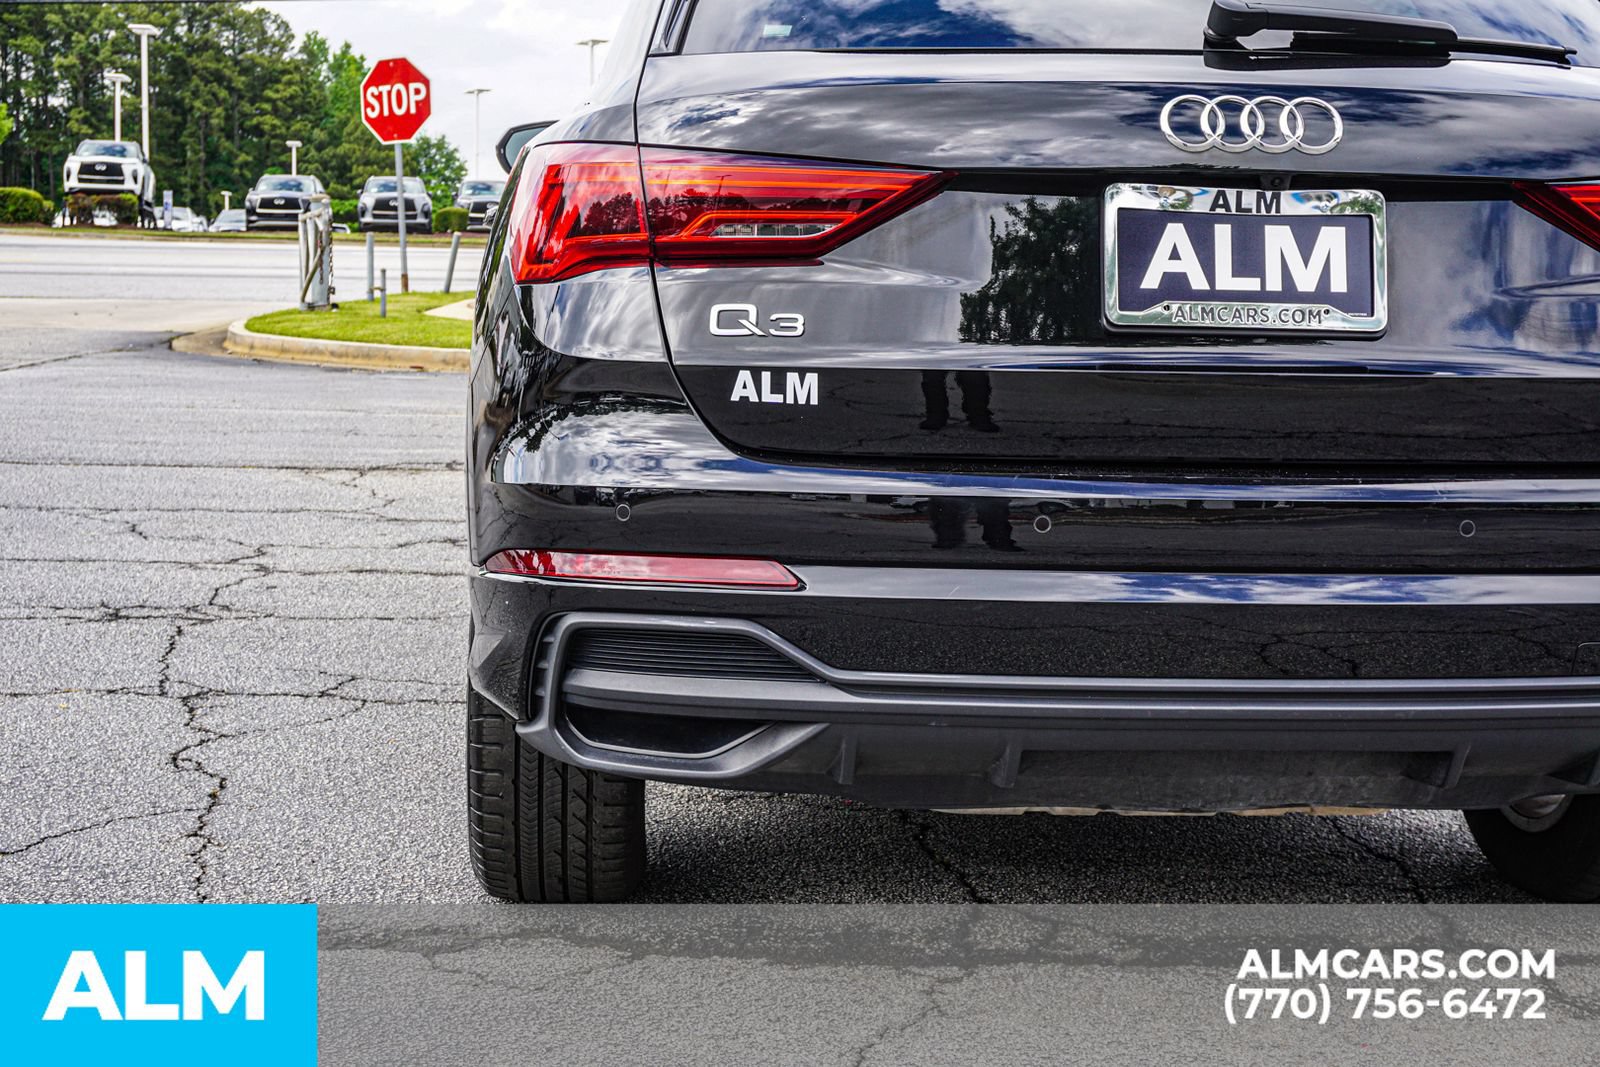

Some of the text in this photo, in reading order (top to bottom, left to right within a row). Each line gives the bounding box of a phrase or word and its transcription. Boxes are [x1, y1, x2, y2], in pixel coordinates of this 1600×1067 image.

[364, 83, 427, 119] STOP
[1208, 189, 1281, 214] ALM
[1139, 222, 1348, 293] ALM
[708, 302, 805, 337] Q3
[1172, 304, 1323, 326] ALMCARS.COM
[730, 369, 820, 406] ALM
